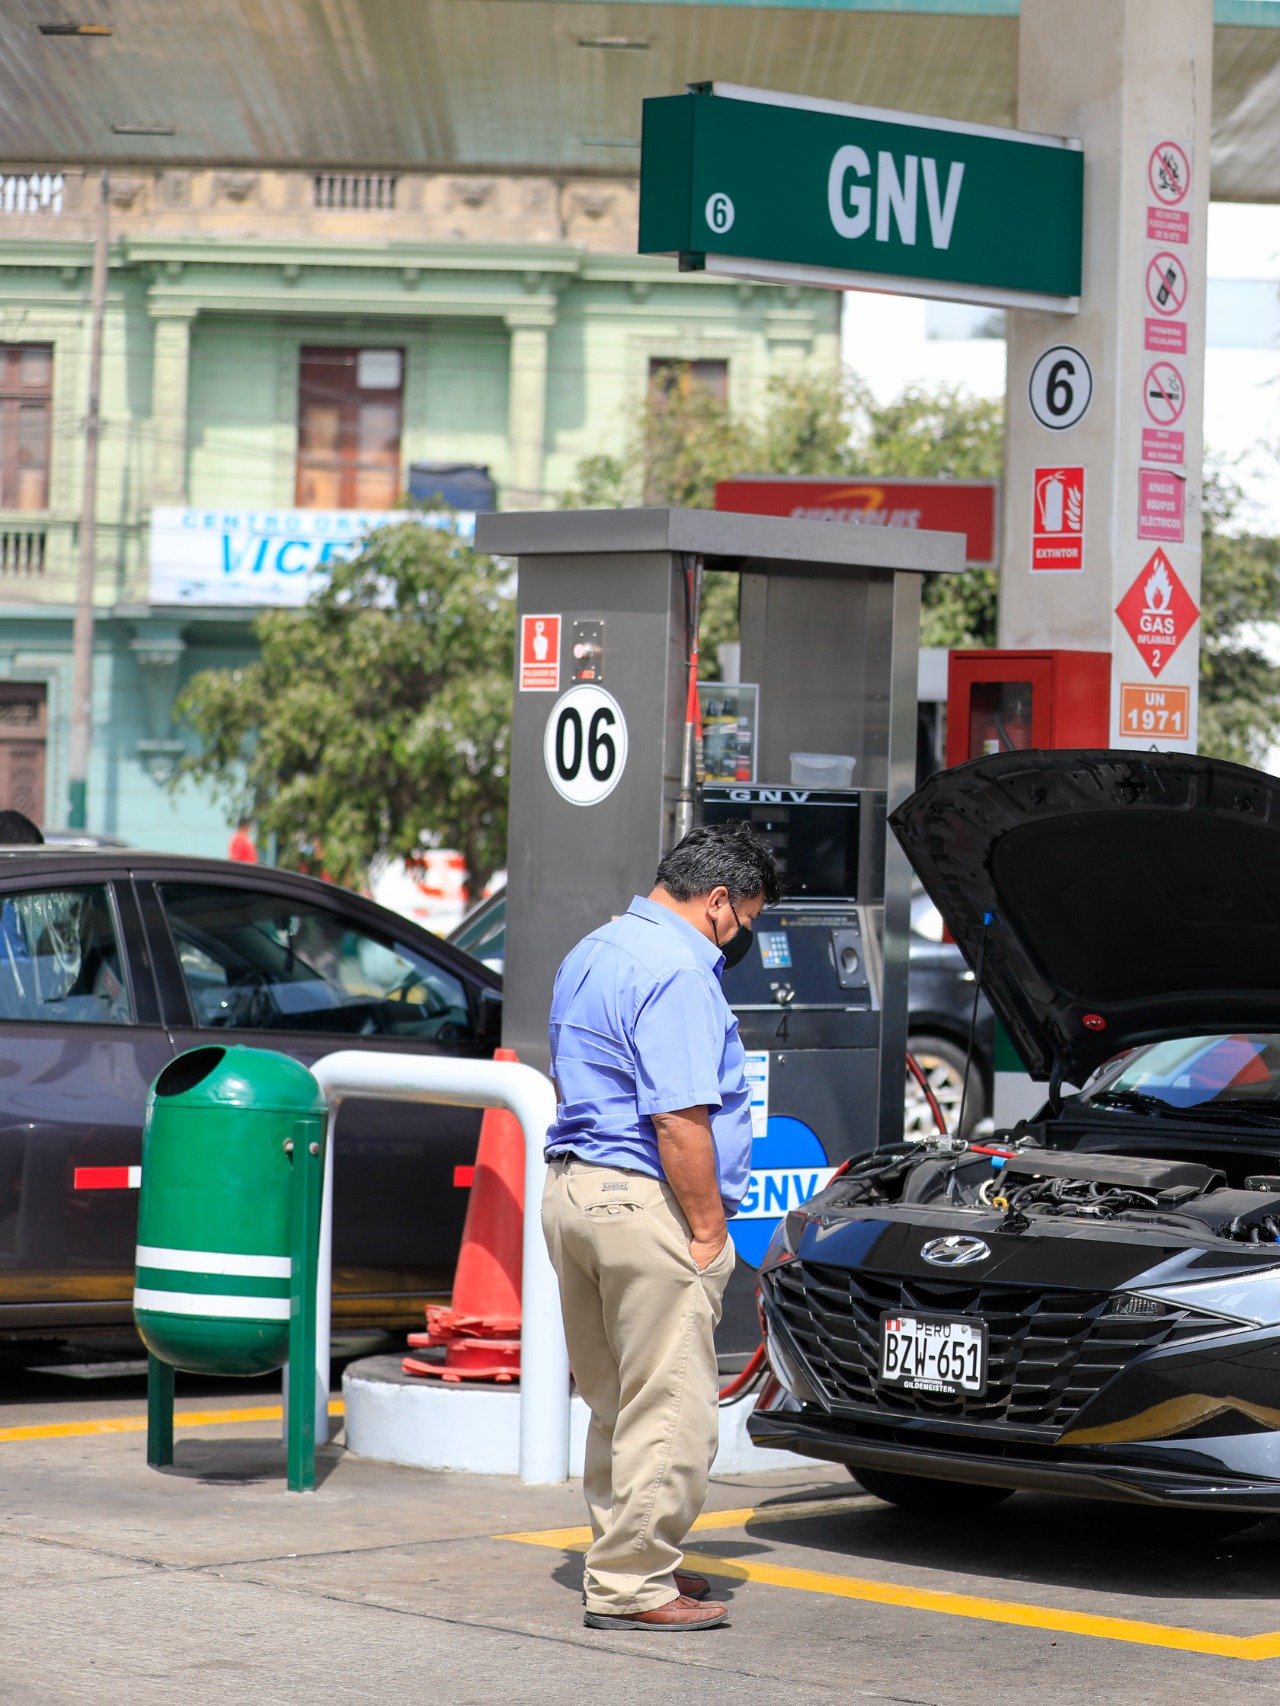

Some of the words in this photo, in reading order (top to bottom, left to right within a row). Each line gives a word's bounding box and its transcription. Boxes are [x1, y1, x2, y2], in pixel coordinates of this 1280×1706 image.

[828, 145, 964, 250] GNV
[712, 197, 727, 229] 6
[1046, 360, 1075, 417] 6
[1148, 482, 1175, 495] APAGUE
[1146, 499, 1176, 512] EQUIPOS
[182, 512, 300, 532] CENTRO
[219, 534, 368, 575] VICE
[1035, 547, 1078, 559] EXTINTOR
[1139, 615, 1175, 635] GAS
[1137, 634, 1177, 646] INFLAMABLE
[1151, 649, 1161, 667] 2
[1144, 692, 1166, 706] UN
[1127, 708, 1182, 731] 1971
[555, 706, 616, 782] 06
[729, 790, 811, 803] GNV
[738, 1173, 819, 1213] GNV
[885, 1333, 979, 1383] BZW-651
